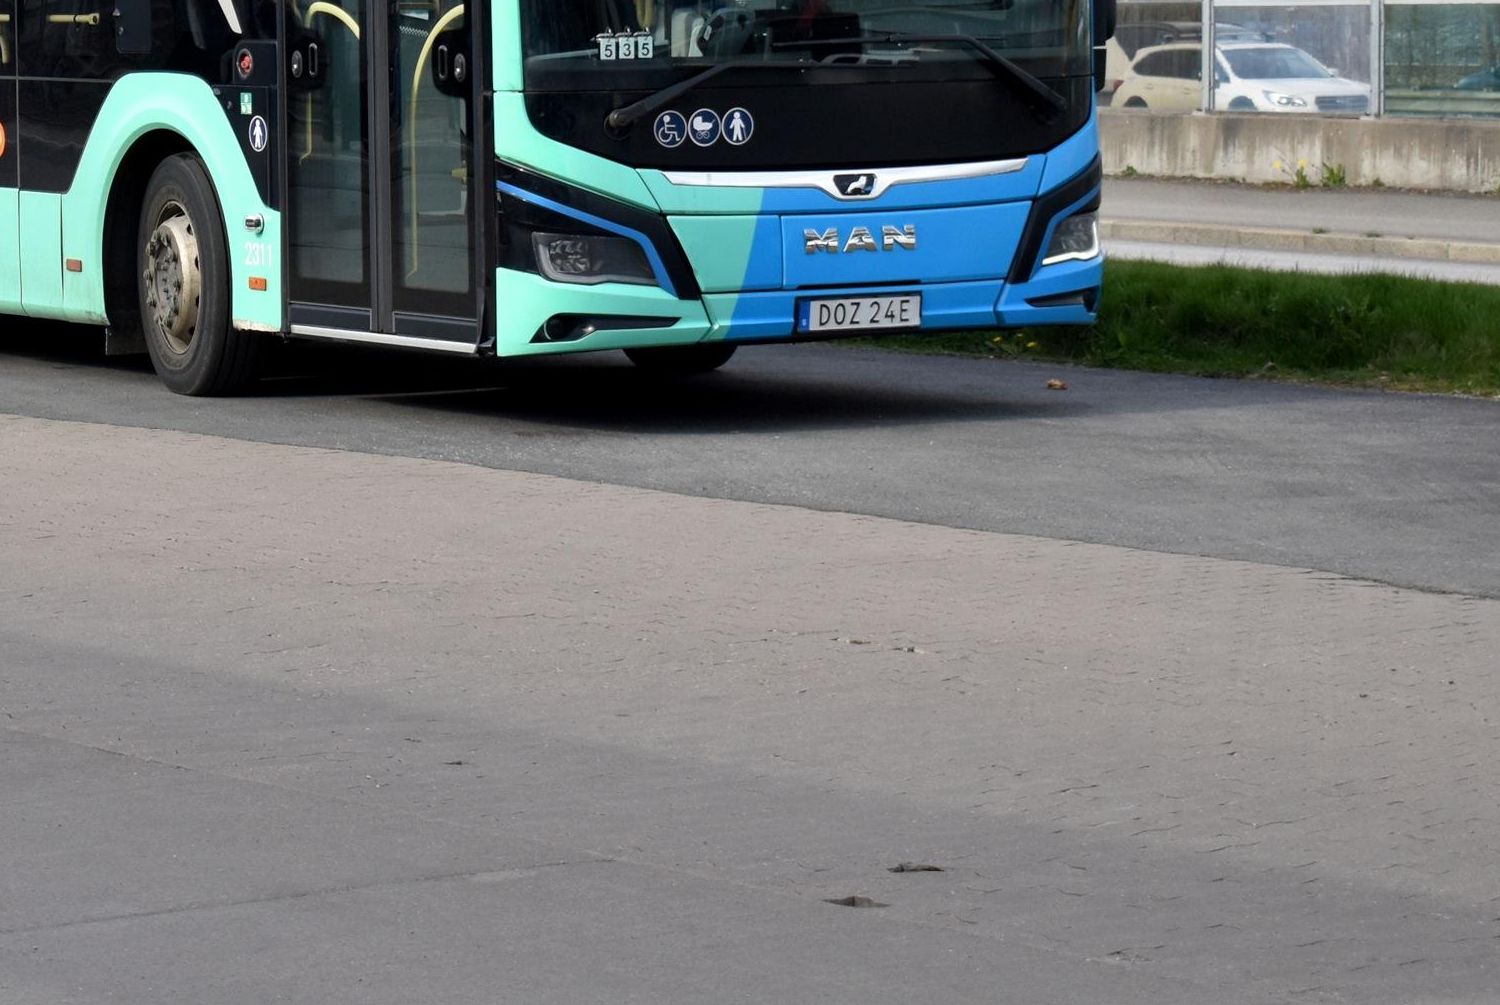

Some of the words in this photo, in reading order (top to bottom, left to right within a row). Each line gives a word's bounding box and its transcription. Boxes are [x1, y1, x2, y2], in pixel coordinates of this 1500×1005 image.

[803, 224, 916, 254] MAN
[244, 242, 272, 267] 2311
[819, 302, 860, 327] DOZ
[869, 299, 910, 324] 24E
